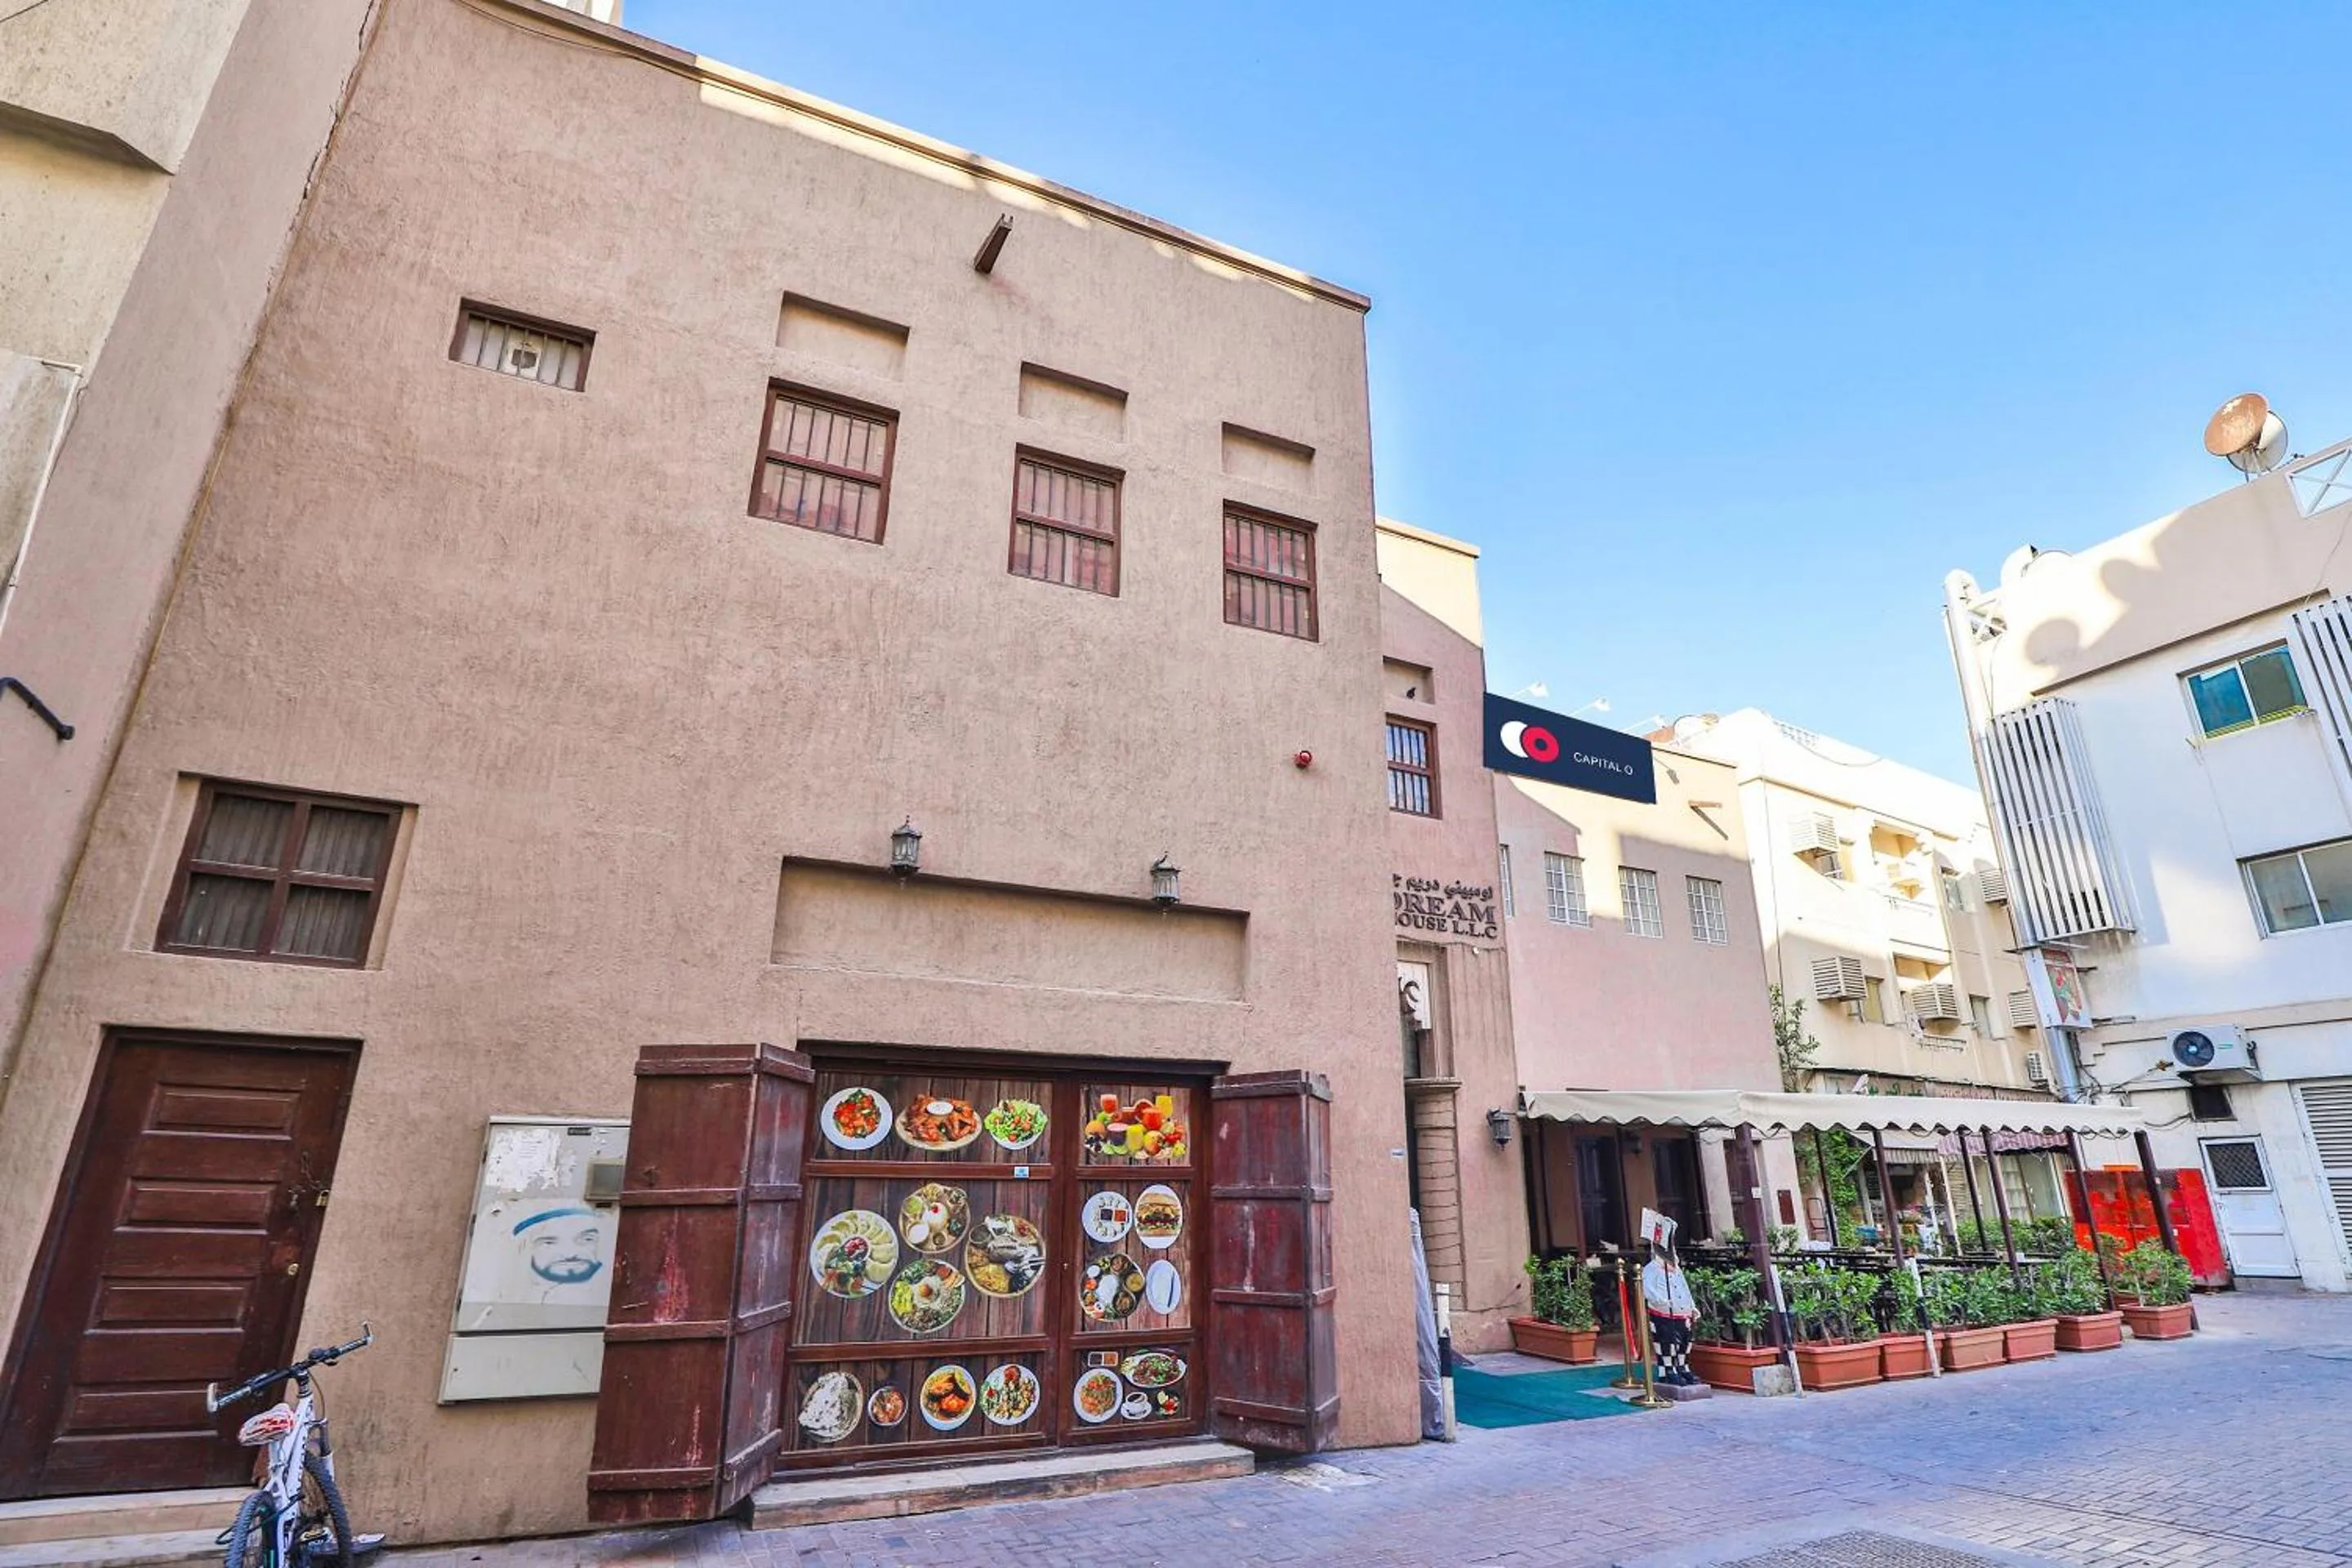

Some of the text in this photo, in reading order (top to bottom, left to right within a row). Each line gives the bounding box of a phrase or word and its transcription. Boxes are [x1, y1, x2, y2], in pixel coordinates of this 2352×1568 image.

[1573, 751, 1633, 776] CAPITAL O
[1394, 911, 1448, 933] OUSE
